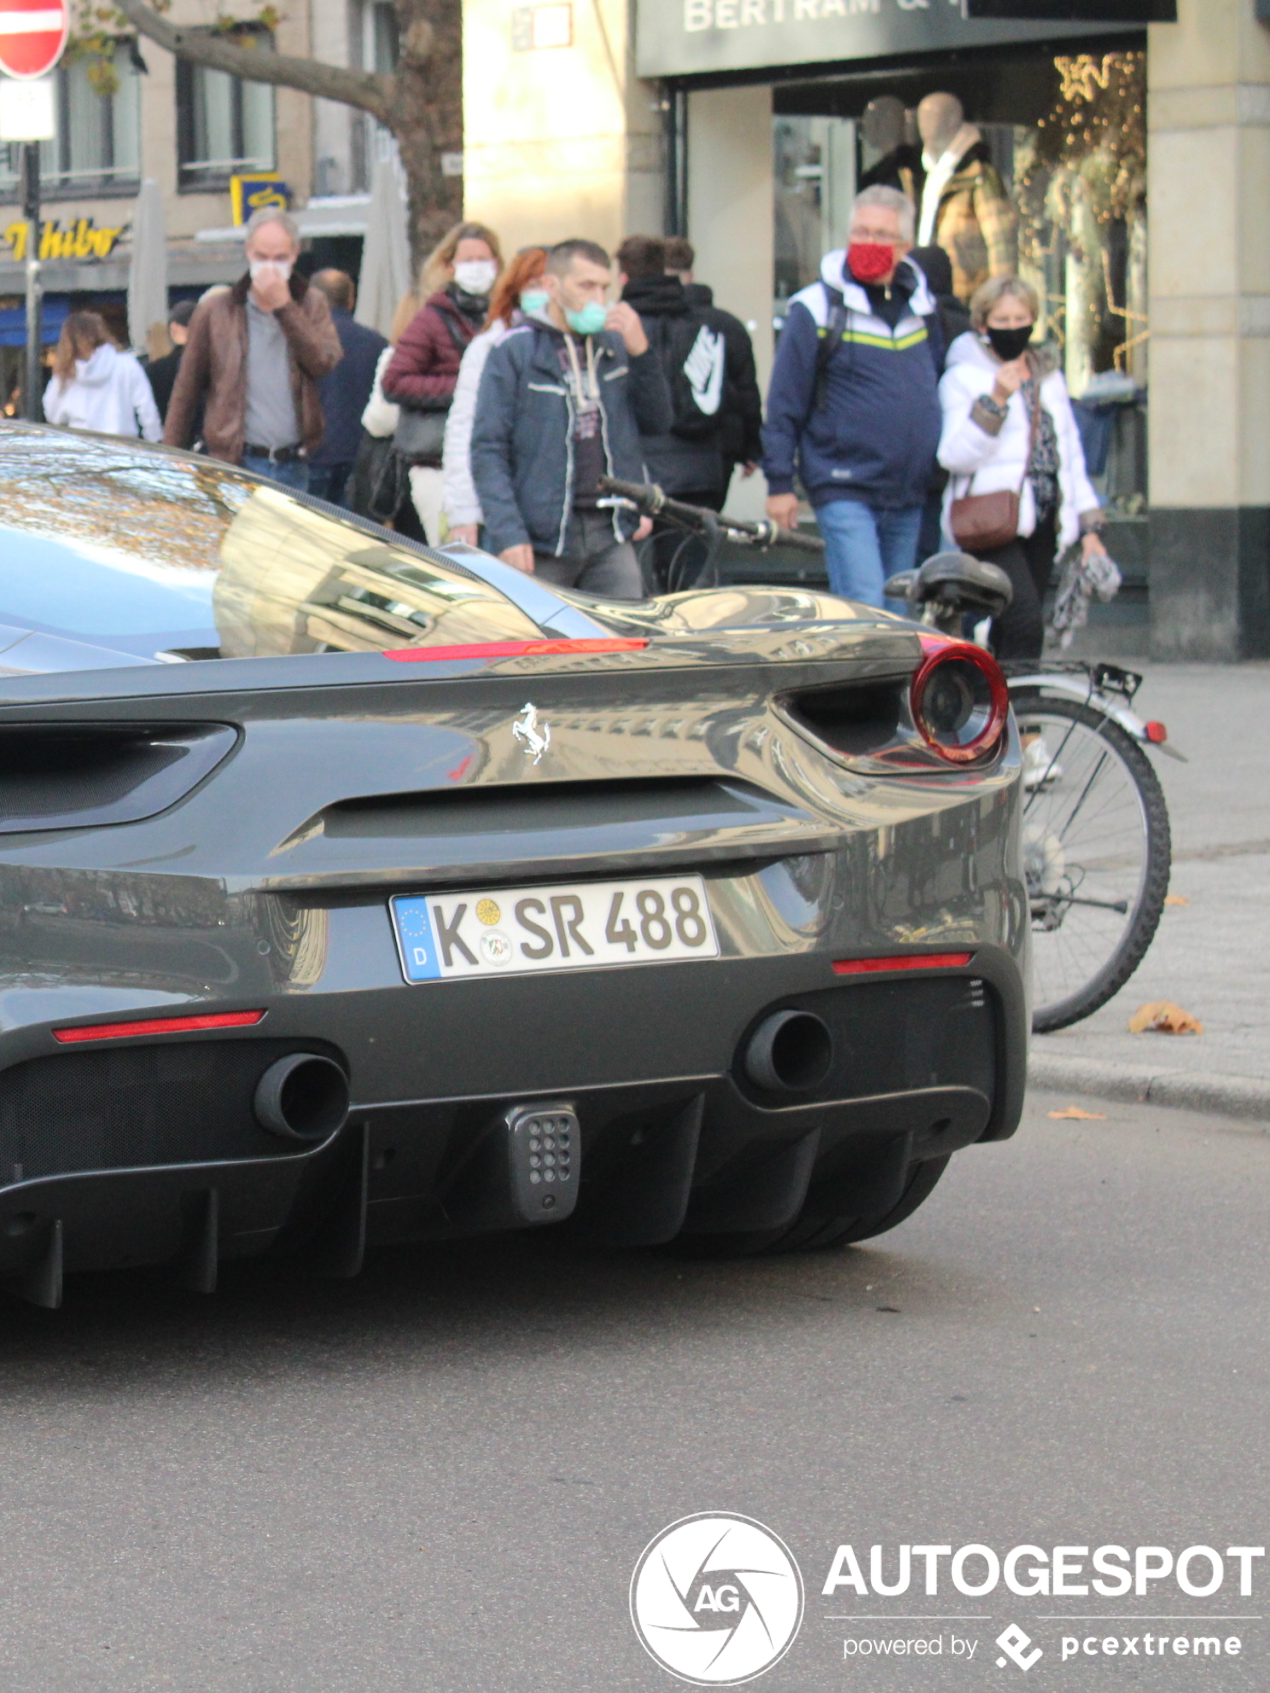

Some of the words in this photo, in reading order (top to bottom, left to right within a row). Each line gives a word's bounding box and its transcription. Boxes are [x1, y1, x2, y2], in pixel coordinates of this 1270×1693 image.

[433, 903, 480, 968] K
[514, 895, 595, 960] SR
[604, 886, 708, 953] 488
[413, 947, 428, 966] D
